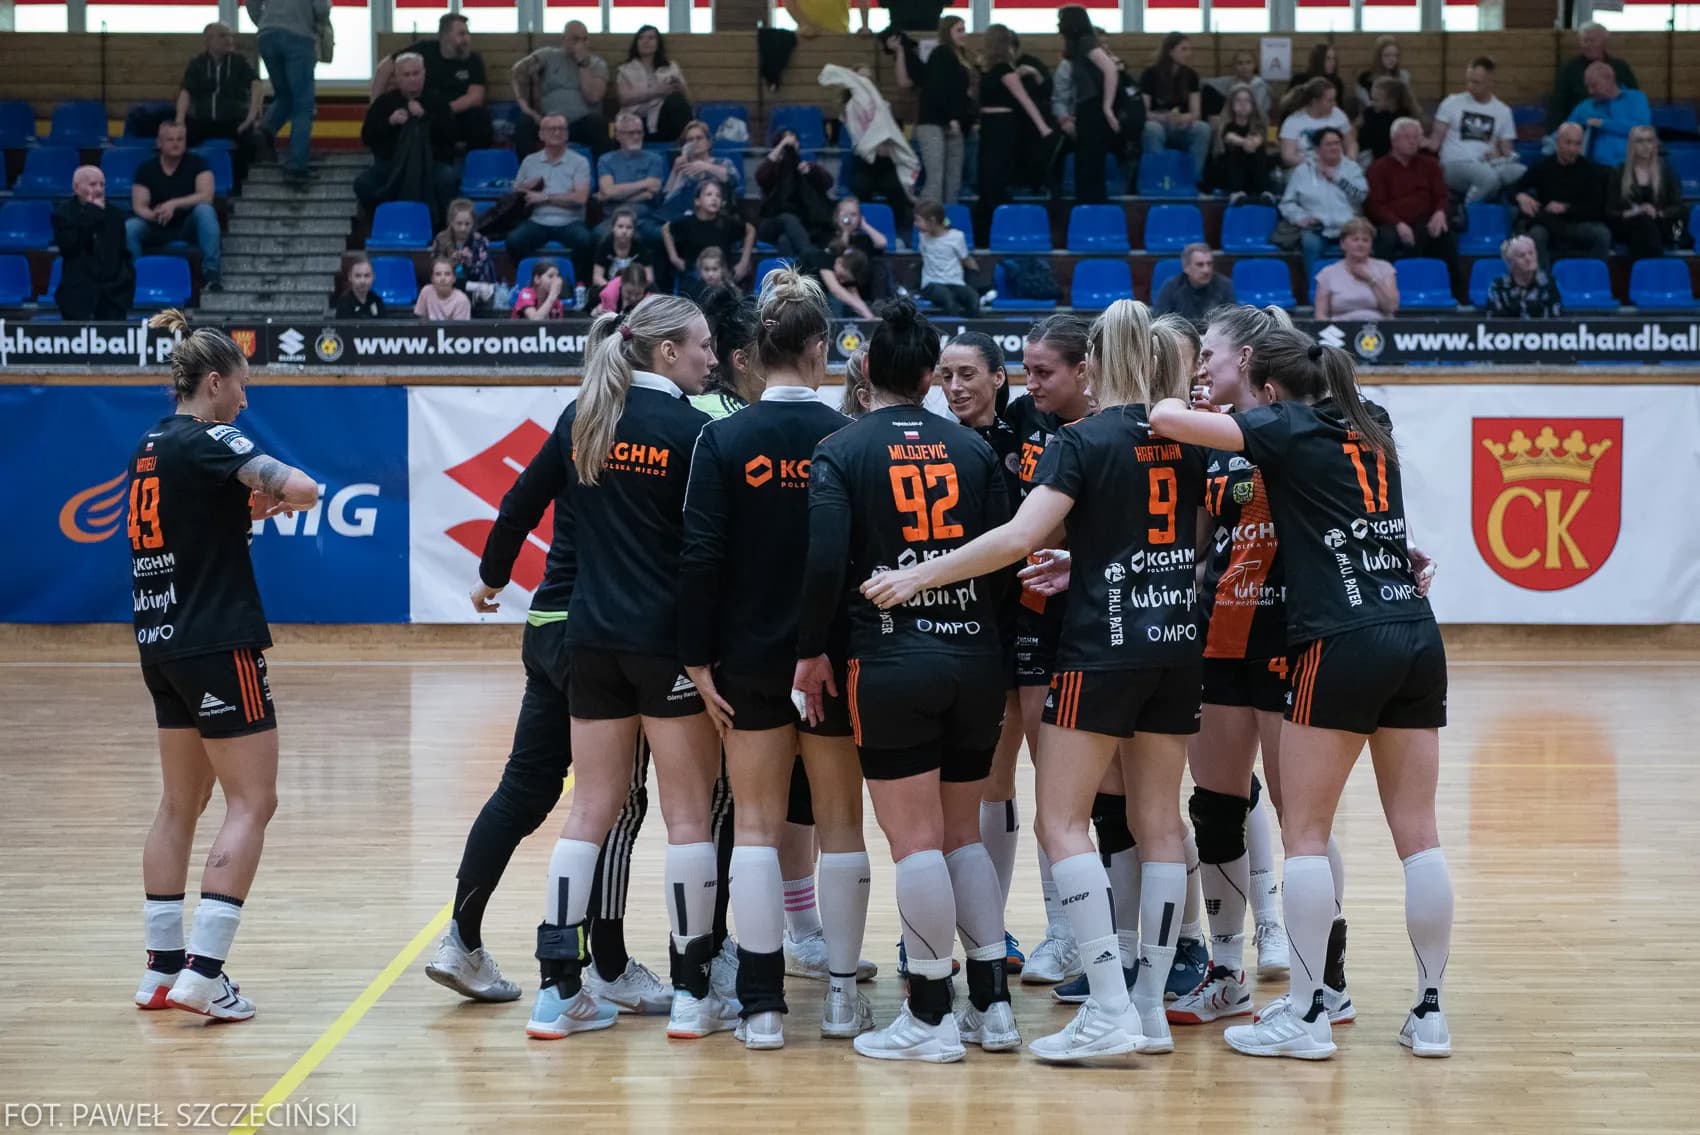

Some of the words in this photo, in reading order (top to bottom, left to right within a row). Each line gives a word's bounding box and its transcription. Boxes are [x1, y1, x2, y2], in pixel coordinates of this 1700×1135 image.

[1133, 443, 1183, 463] HARTMAN
[127, 477, 164, 551] 49
[889, 463, 964, 542] 92
[1148, 467, 1178, 545] 9
[1487, 486, 1592, 570] CK
[136, 552, 176, 571] KGHM
[1147, 548, 1195, 567] KGHM
[1131, 580, 1197, 612] lubin.pl
[1344, 578, 1363, 607] PATER
[1109, 616, 1124, 647] PATER
